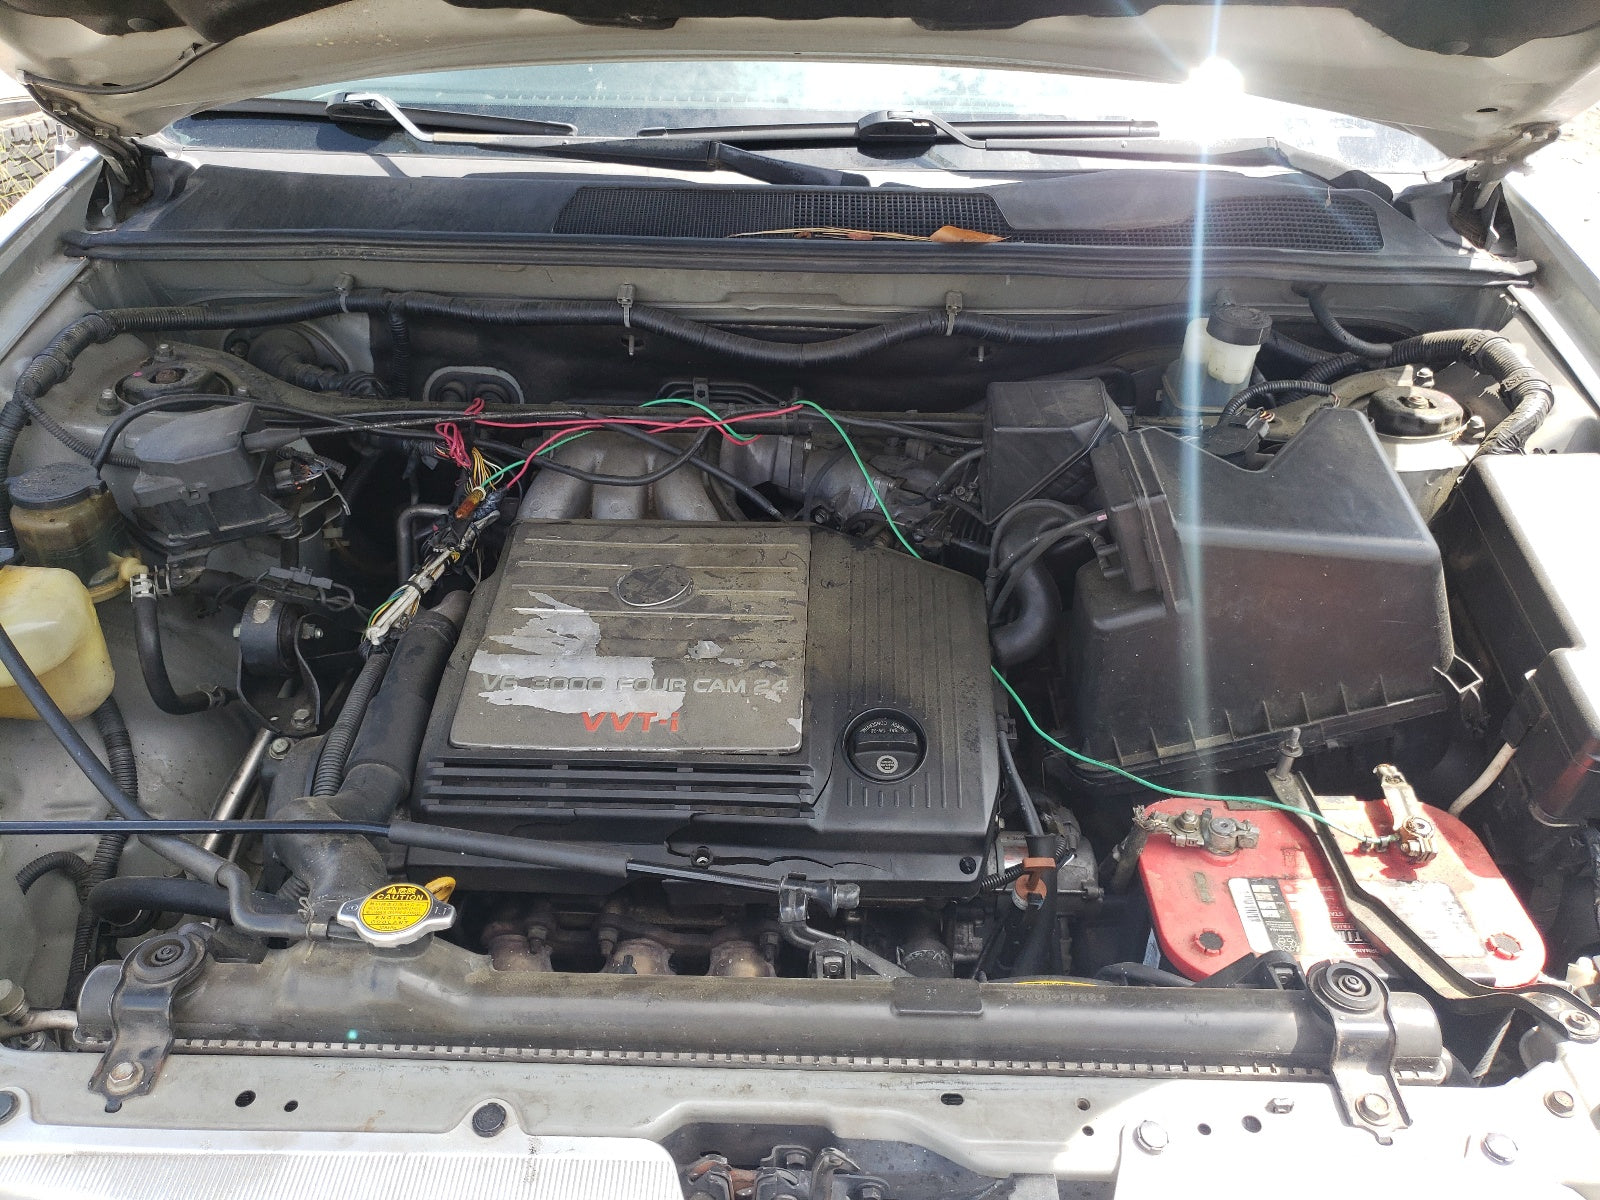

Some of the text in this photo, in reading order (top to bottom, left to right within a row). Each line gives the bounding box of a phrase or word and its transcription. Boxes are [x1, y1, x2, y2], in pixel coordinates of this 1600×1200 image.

[482, 674, 789, 693] V6 3000 FOUR CAM 24
[581, 711, 679, 732] VVT-i
[376, 893, 424, 901] CAUTION
